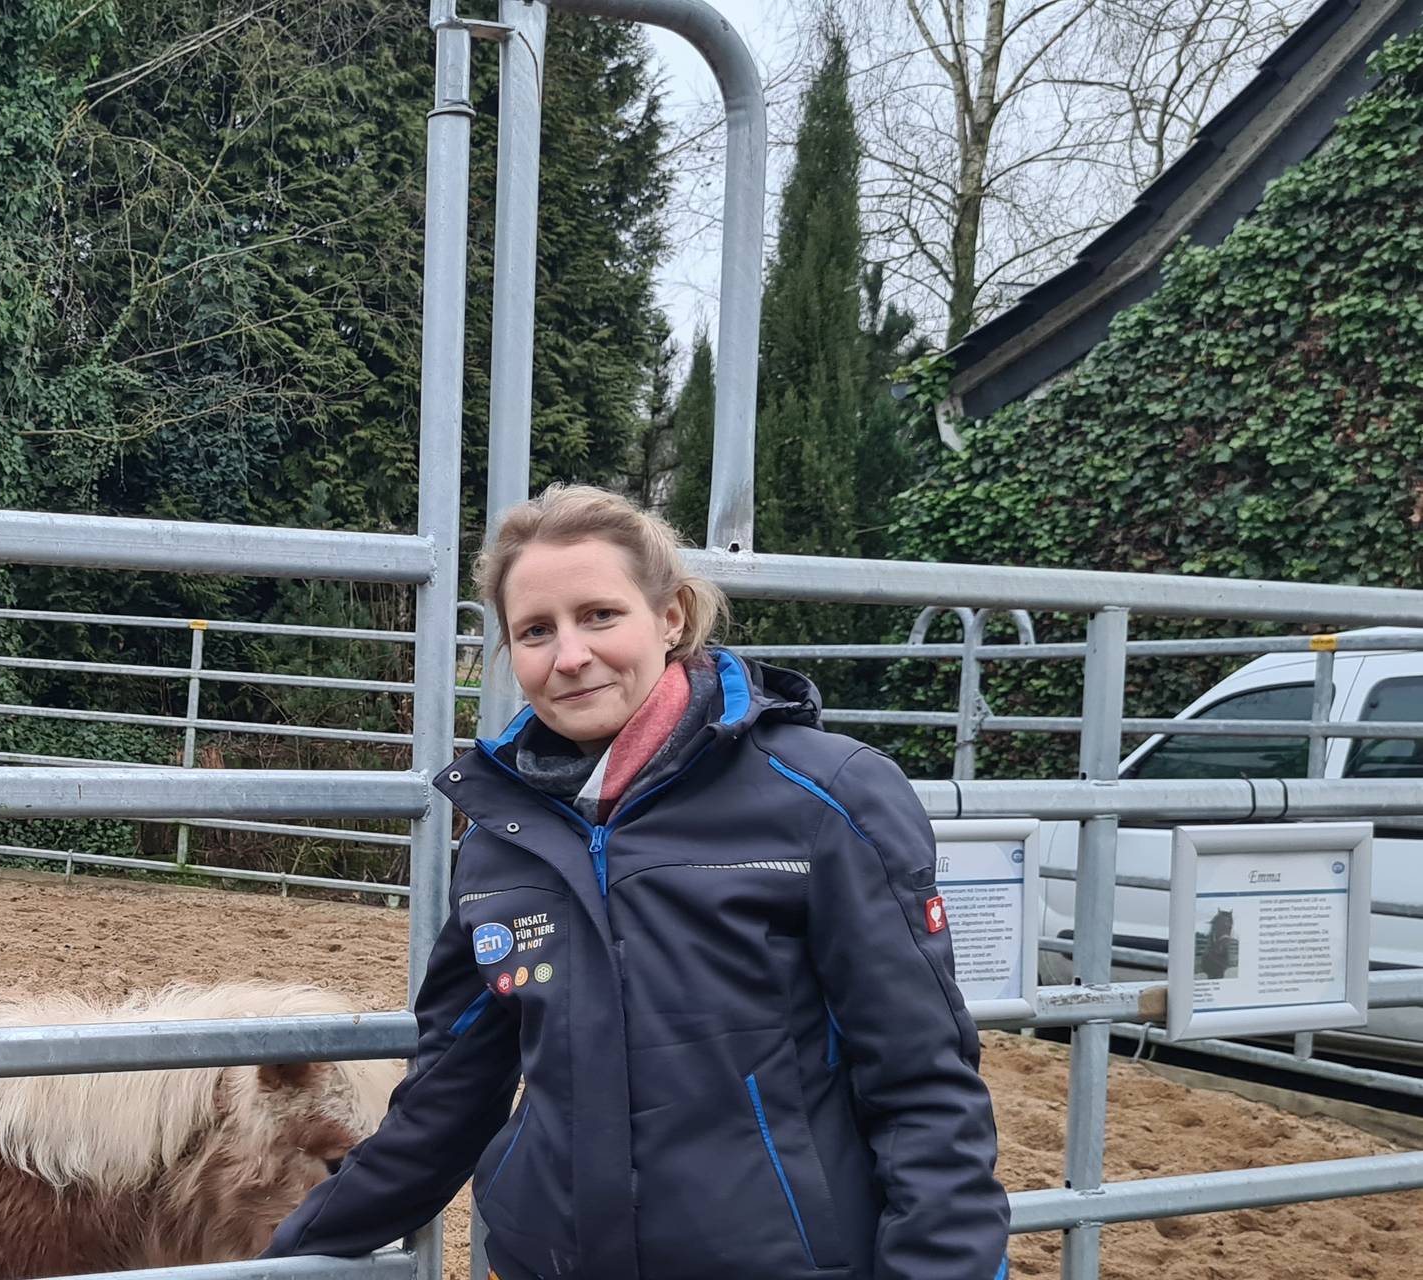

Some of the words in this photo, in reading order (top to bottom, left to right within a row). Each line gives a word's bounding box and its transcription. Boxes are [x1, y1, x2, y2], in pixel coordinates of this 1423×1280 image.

[937, 856, 949, 873] lli
[1249, 869, 1281, 883] Emma
[513, 913, 548, 929] EINSATZ
[515, 926, 532, 941] FÜR
[533, 923, 556, 937] TIERE
[517, 941, 526, 953] IN
[527, 938, 544, 950] NOT
